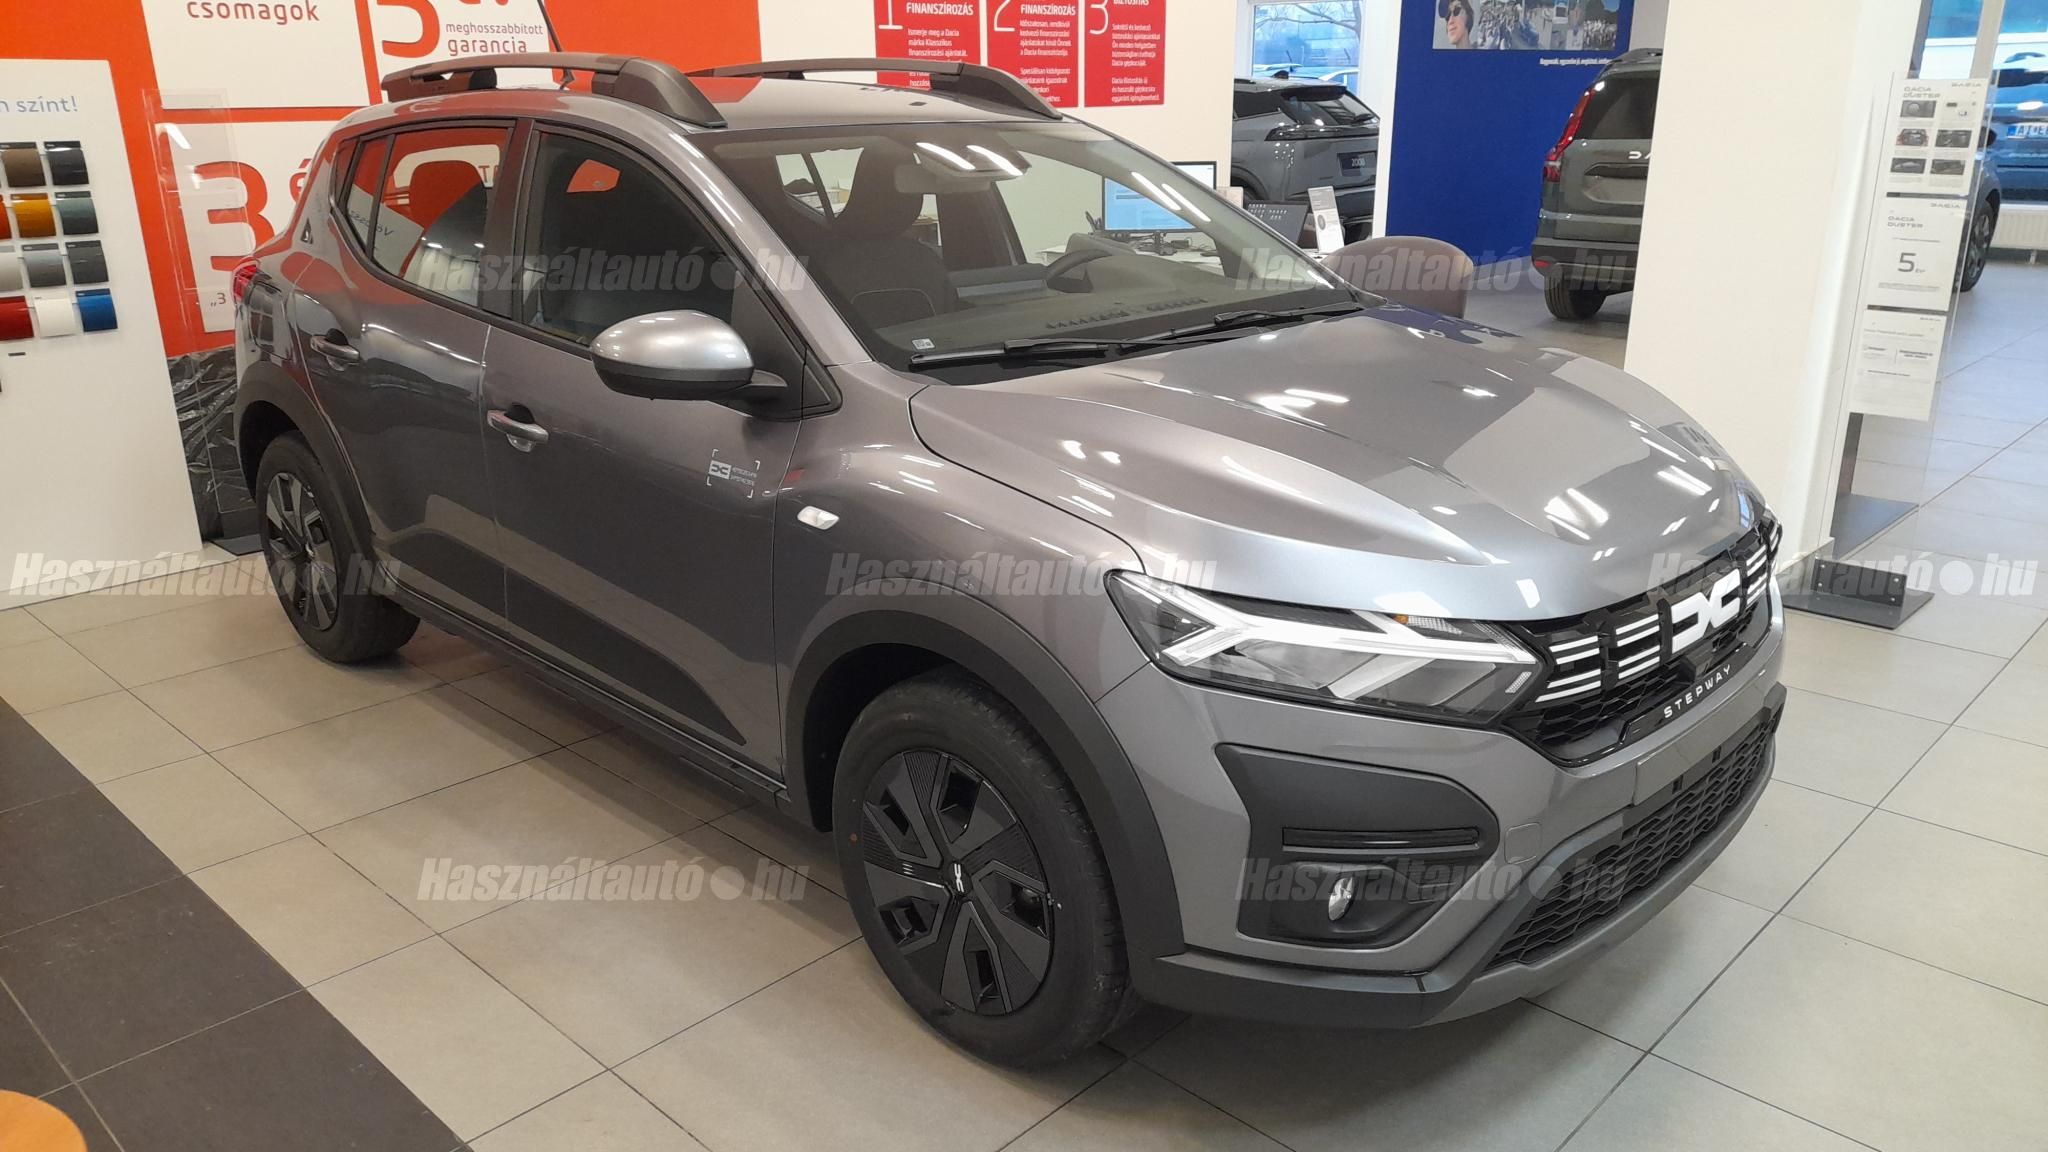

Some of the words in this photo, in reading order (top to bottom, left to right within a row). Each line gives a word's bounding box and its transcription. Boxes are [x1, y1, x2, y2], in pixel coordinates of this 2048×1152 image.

[187, 0, 320, 25] csomagok
[906, 1, 974, 15] FINANSZÍROZÁS
[1021, 4, 1076, 16] FINANSZÍROZÁS
[448, 37, 527, 56] garancia
[193, 161, 275, 272] 3
[1897, 252, 1916, 272] 5
[1663, 664, 1732, 718] STEPWAY
